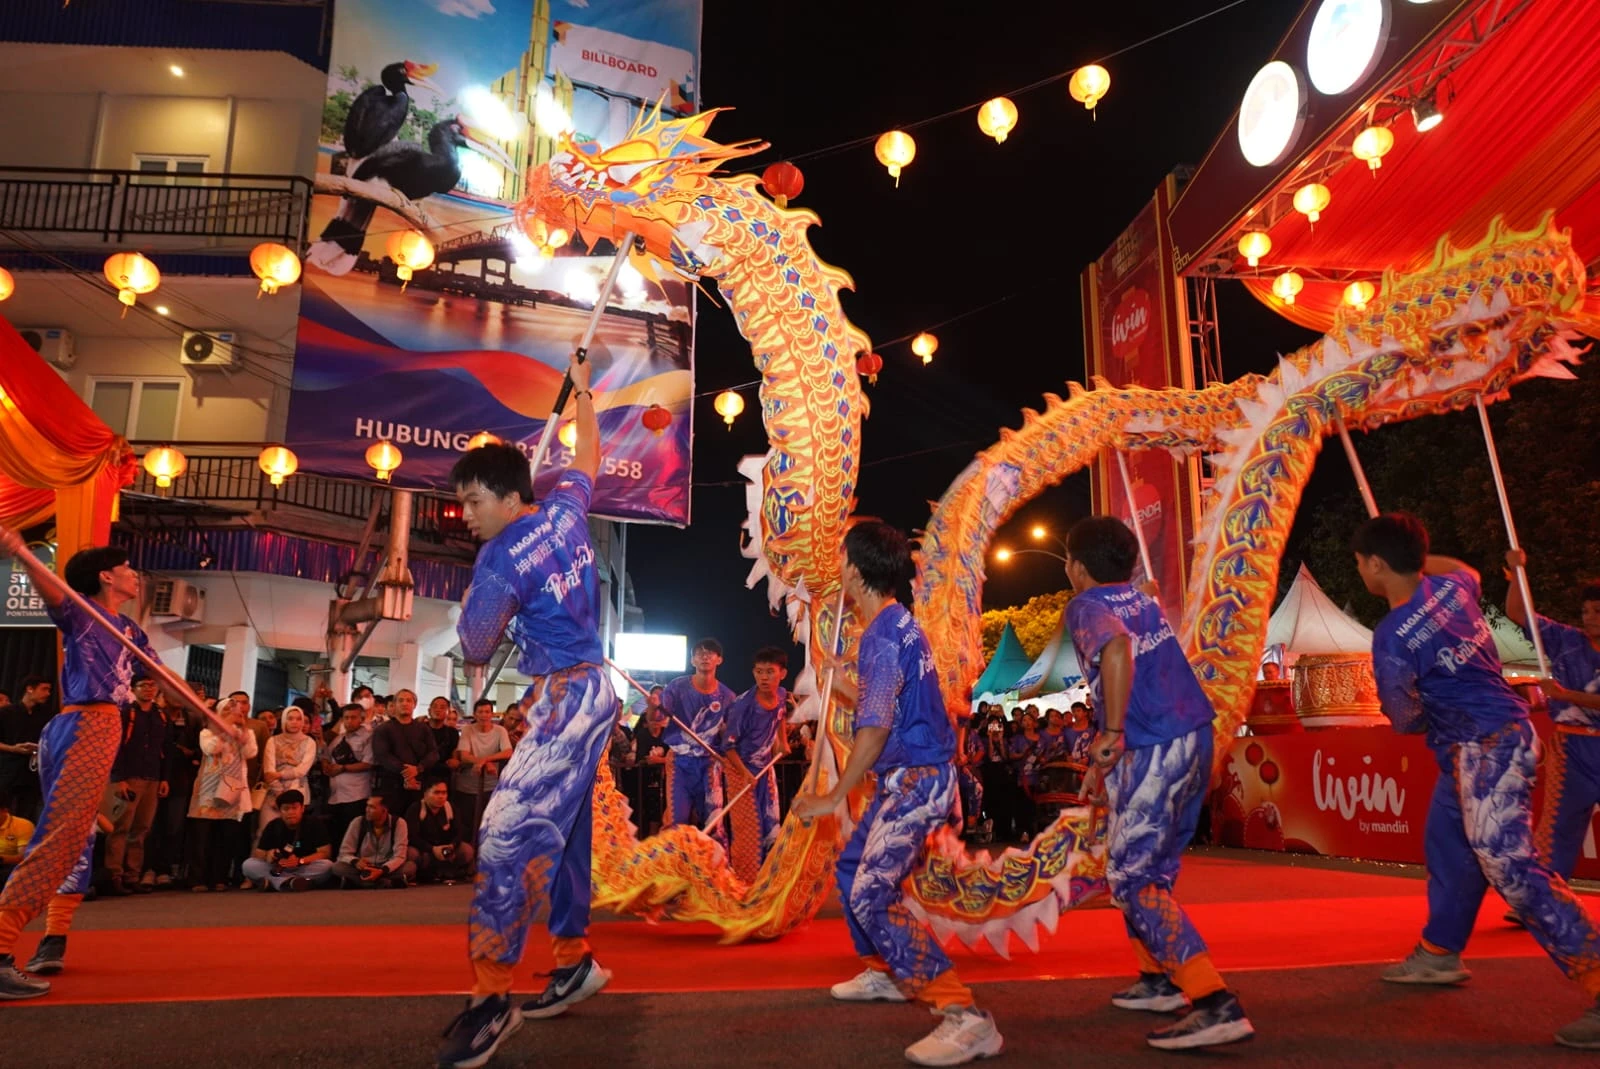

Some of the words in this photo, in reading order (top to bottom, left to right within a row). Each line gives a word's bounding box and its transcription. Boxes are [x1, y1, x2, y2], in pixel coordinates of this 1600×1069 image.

[582, 49, 657, 77] BILLBOARD
[508, 531, 538, 556] NAGA
[1396, 612, 1423, 637] NAGA
[1359, 819, 1370, 834] by
[1371, 821, 1409, 834] mandiri
